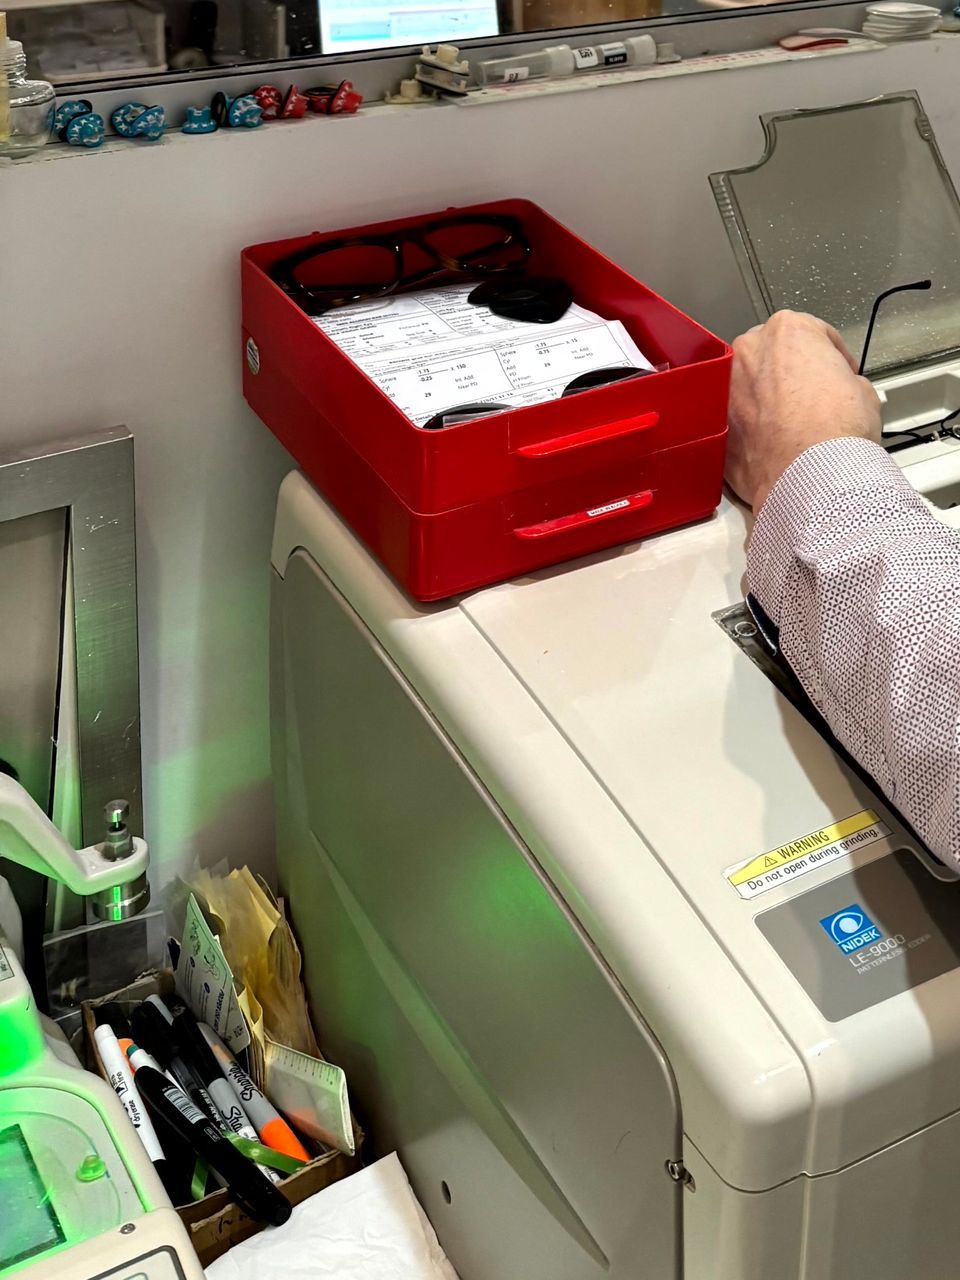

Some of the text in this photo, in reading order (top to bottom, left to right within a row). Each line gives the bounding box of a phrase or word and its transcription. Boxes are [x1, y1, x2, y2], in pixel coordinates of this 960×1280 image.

[747, 827, 880, 891] Do not open during grinding.
[777, 831, 830, 860] WARNING
[841, 928, 881, 953] NIDEK
[848, 934, 905, 968] LE-9000
[228, 1060, 264, 1101] Sharpie
